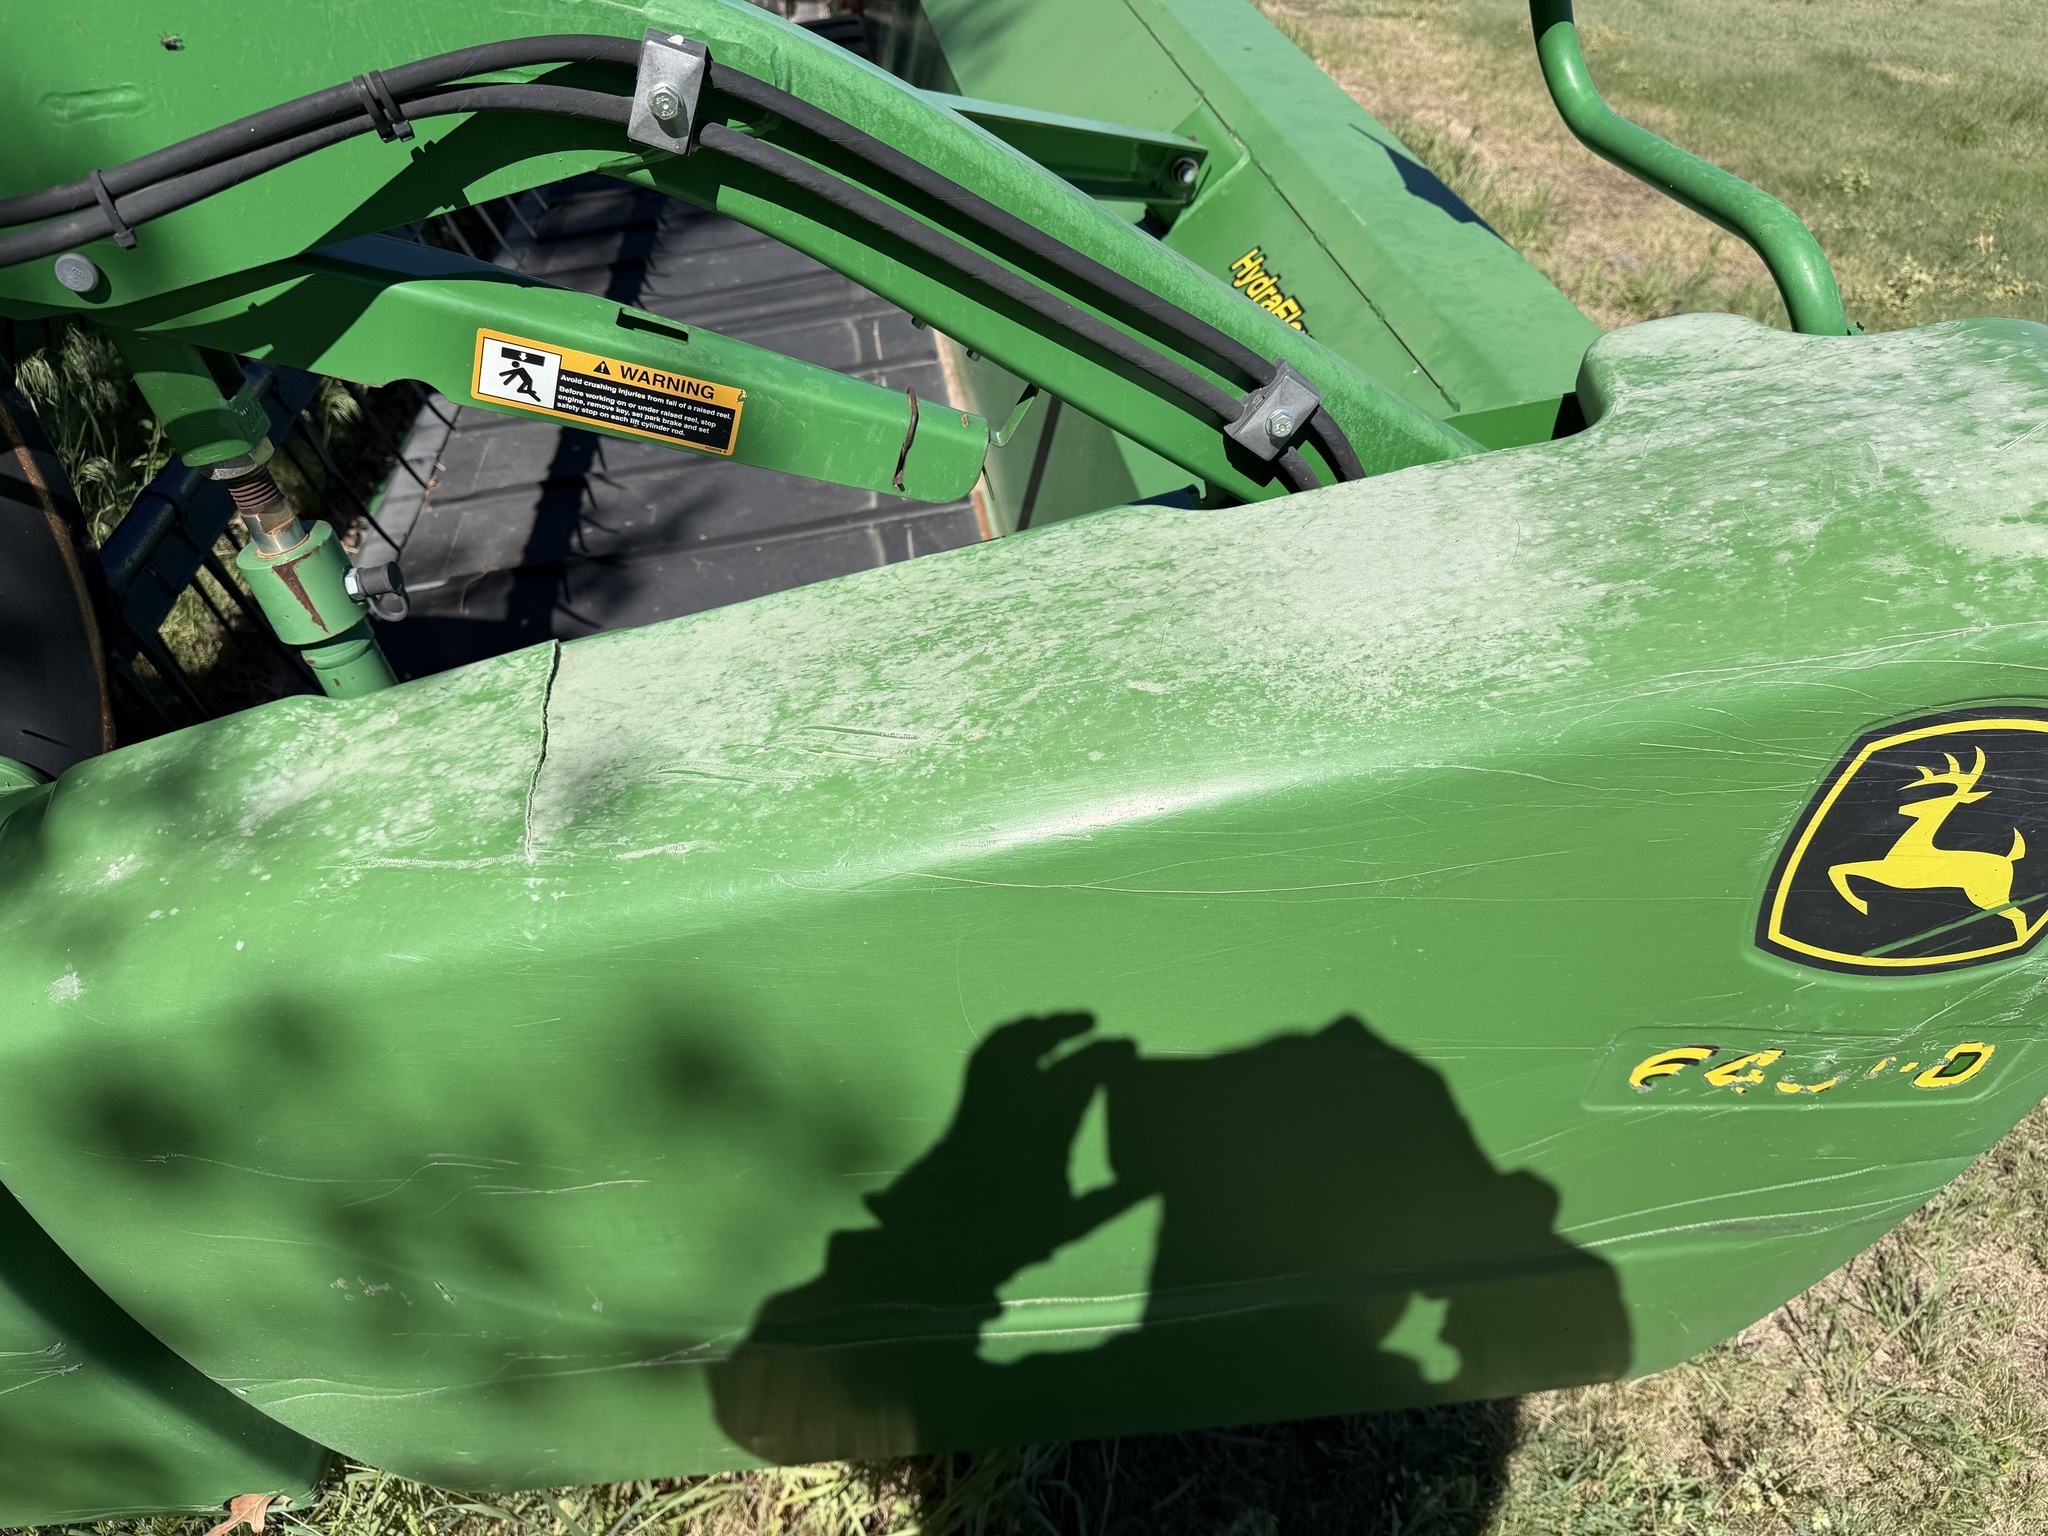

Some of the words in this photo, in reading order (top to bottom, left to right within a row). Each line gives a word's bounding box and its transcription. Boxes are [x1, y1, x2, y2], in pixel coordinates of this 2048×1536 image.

[1230, 246, 1310, 336] HydraFl
[560, 374, 583, 385] Avoid
[583, 380, 617, 394] crushing
[618, 387, 646, 400] injuries
[647, 394, 665, 404] from
[665, 398, 678, 407] fall
[693, 405, 716, 416] raised
[716, 411, 732, 420] reel.
[620, 364, 715, 400] WARNING
[556, 401, 580, 413] safety
[581, 407, 598, 417] stop
[599, 411, 610, 419] on
[610, 413, 629, 423] each
[629, 417, 640, 426] lift
[640, 420, 671, 433] cylinder
[671, 427, 686, 436] rod.
[559, 385, 585, 397] Before
[585, 392, 616, 405] working
[637, 404, 660, 414] under
[660, 410, 684, 420] raised
[700, 419, 717, 429] stop
[586, 400, 615, 412] remove
[615, 406, 631, 417] key,
[631, 411, 644, 419] set
[644, 413, 662, 423] park
[662, 417, 683, 428] brake
[683, 422, 698, 431] and
[698, 426, 710, 434] set
